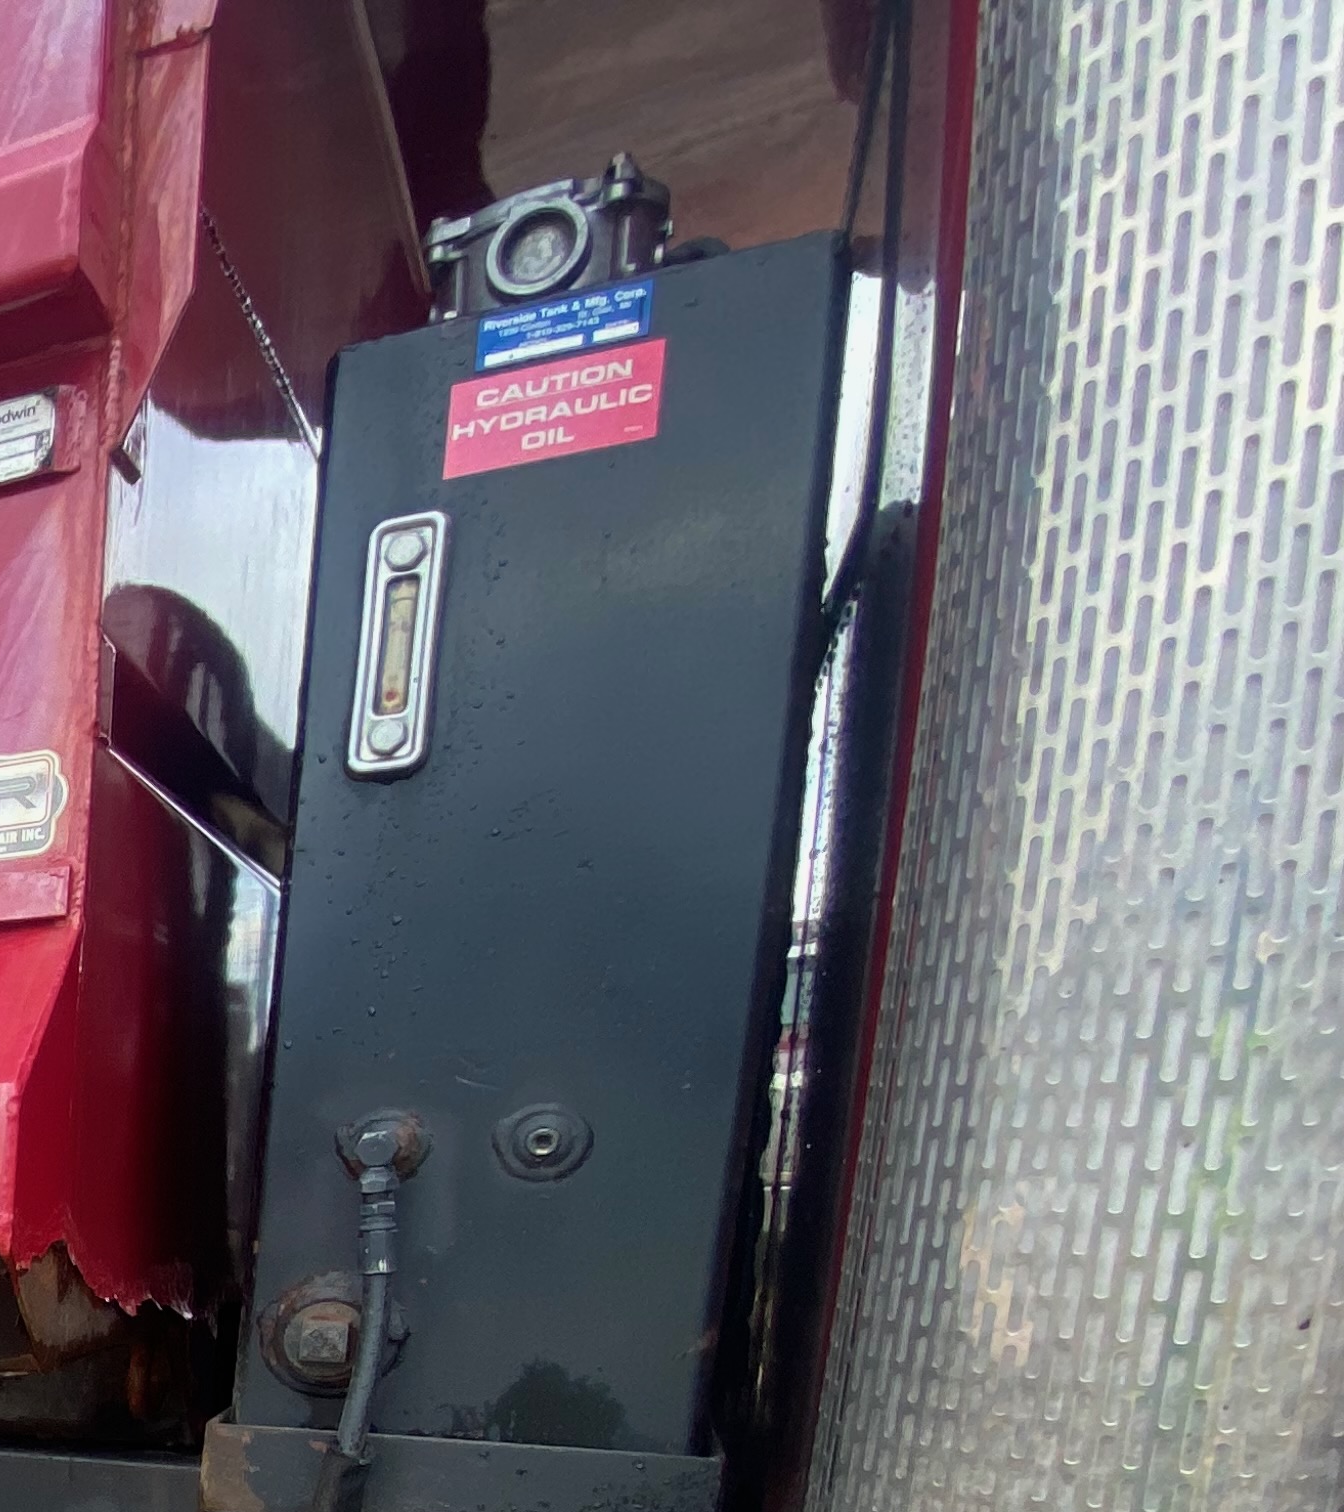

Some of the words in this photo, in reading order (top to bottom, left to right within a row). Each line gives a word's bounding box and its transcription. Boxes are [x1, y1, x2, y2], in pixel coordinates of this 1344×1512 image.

[484, 313, 537, 332] Riverside
[540, 303, 569, 319] Tank
[571, 300, 580, 312] &
[614, 288, 647, 302] Corp.
[476, 358, 634, 408] CAUTION
[451, 384, 653, 441] HYDRAULIC
[521, 426, 575, 450] OIL
[21, 827, 46, 842] INC.
